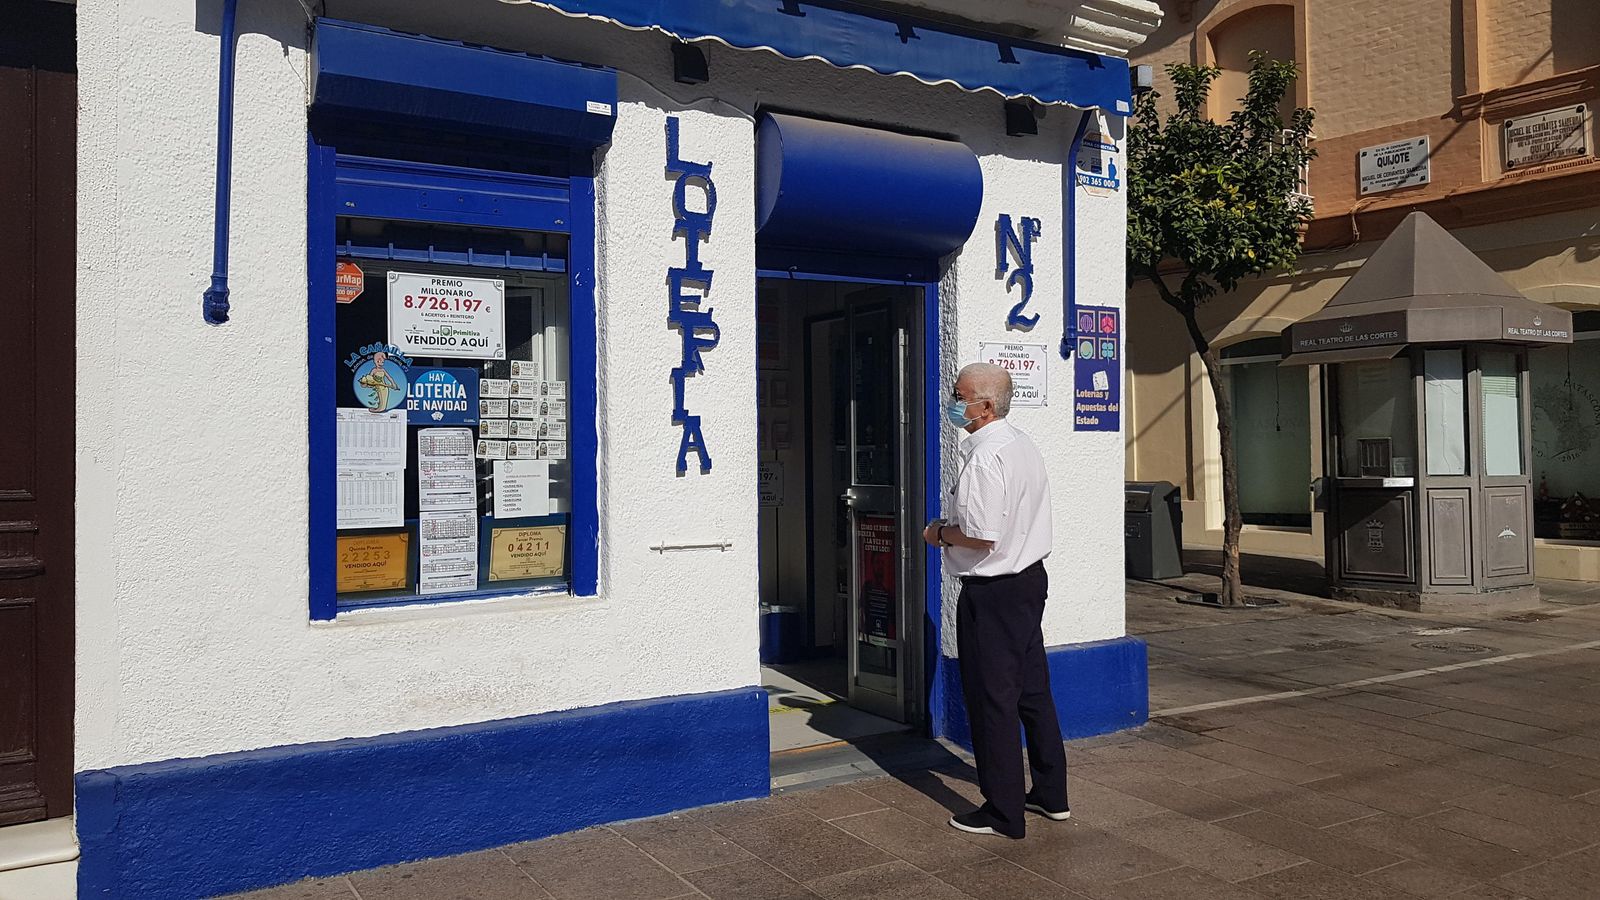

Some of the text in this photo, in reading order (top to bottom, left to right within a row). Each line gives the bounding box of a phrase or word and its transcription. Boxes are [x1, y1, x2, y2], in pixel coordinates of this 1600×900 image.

[1377, 152, 1410, 168] QUIJOTE
[1091, 177, 1102, 186] 365
[1103, 180, 1115, 188] 000
[431, 279, 463, 287] PREMIO
[421, 288, 474, 298] MILLONARIO
[404, 295, 482, 312] 8.726.197
[1006, 269, 1040, 329] 2
[1508, 327, 1519, 335] REAL
[1520, 328, 1536, 336] TEATRO
[406, 335, 488, 348] VENDIDO AQUÍ
[1300, 339, 1317, 347] REAL
[1319, 336, 1344, 345] TEATRO
[1355, 333, 1369, 341] LAS
[1369, 331, 1398, 340] CORTES
[344, 352, 361, 368] LA
[428, 373, 445, 382] HAY
[407, 380, 467, 399] LOTERÍA
[1022, 389, 1039, 398] AQUÍ
[1105, 391, 1109, 400] y
[407, 399, 467, 411] DE NAVIDAD
[1076, 402, 1119, 413] Apuestas del
[1076, 415, 1099, 424] Estado
[508, 541, 550, 552] 04211
[342, 550, 391, 562] 22253
